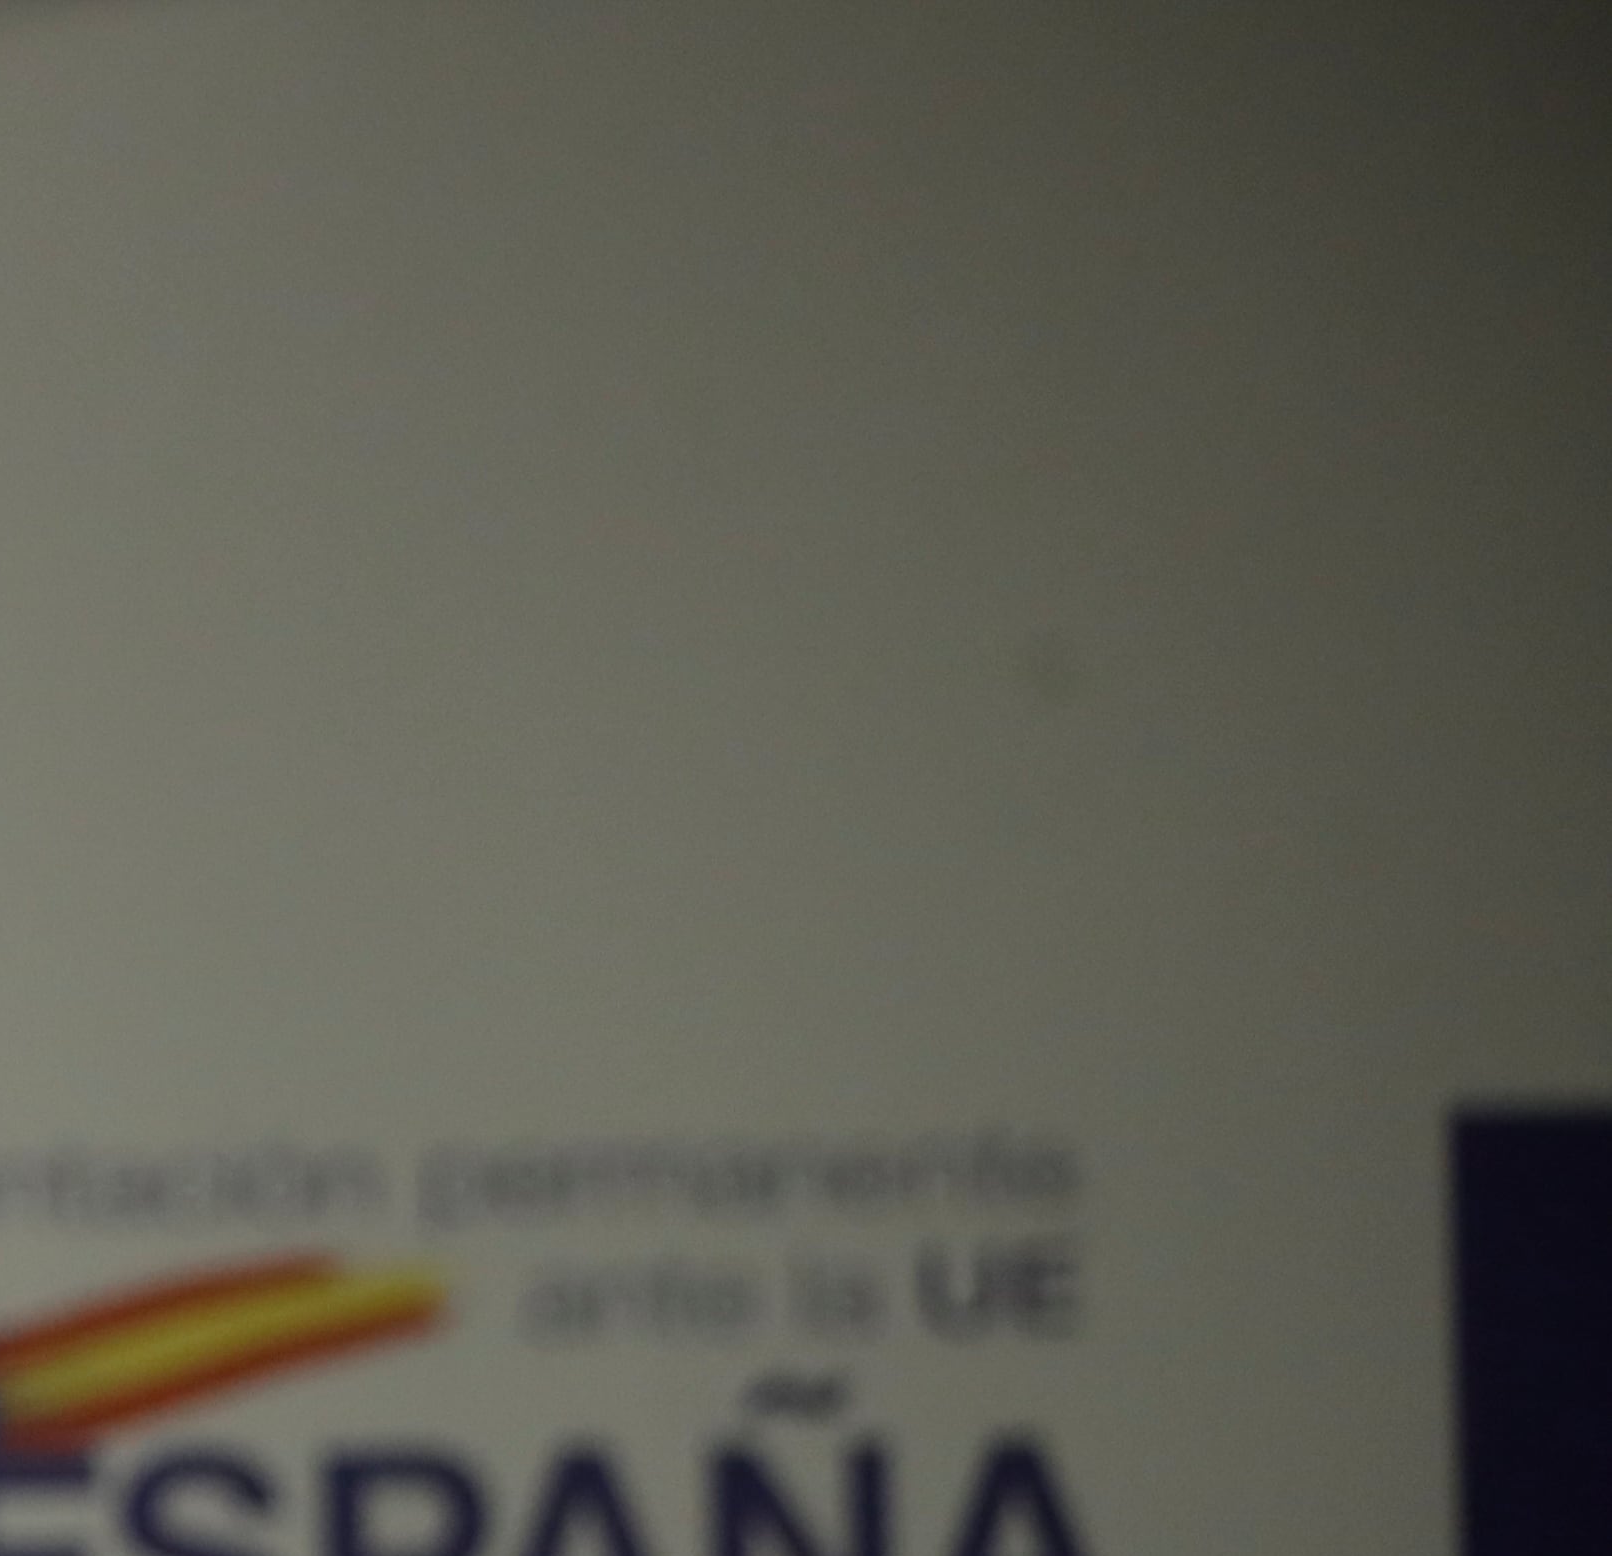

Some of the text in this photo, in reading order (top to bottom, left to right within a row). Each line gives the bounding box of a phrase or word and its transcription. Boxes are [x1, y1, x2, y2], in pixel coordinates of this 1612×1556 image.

[417, 1135, 1081, 1235] permanente
[523, 1245, 1079, 1340] ante la UE
